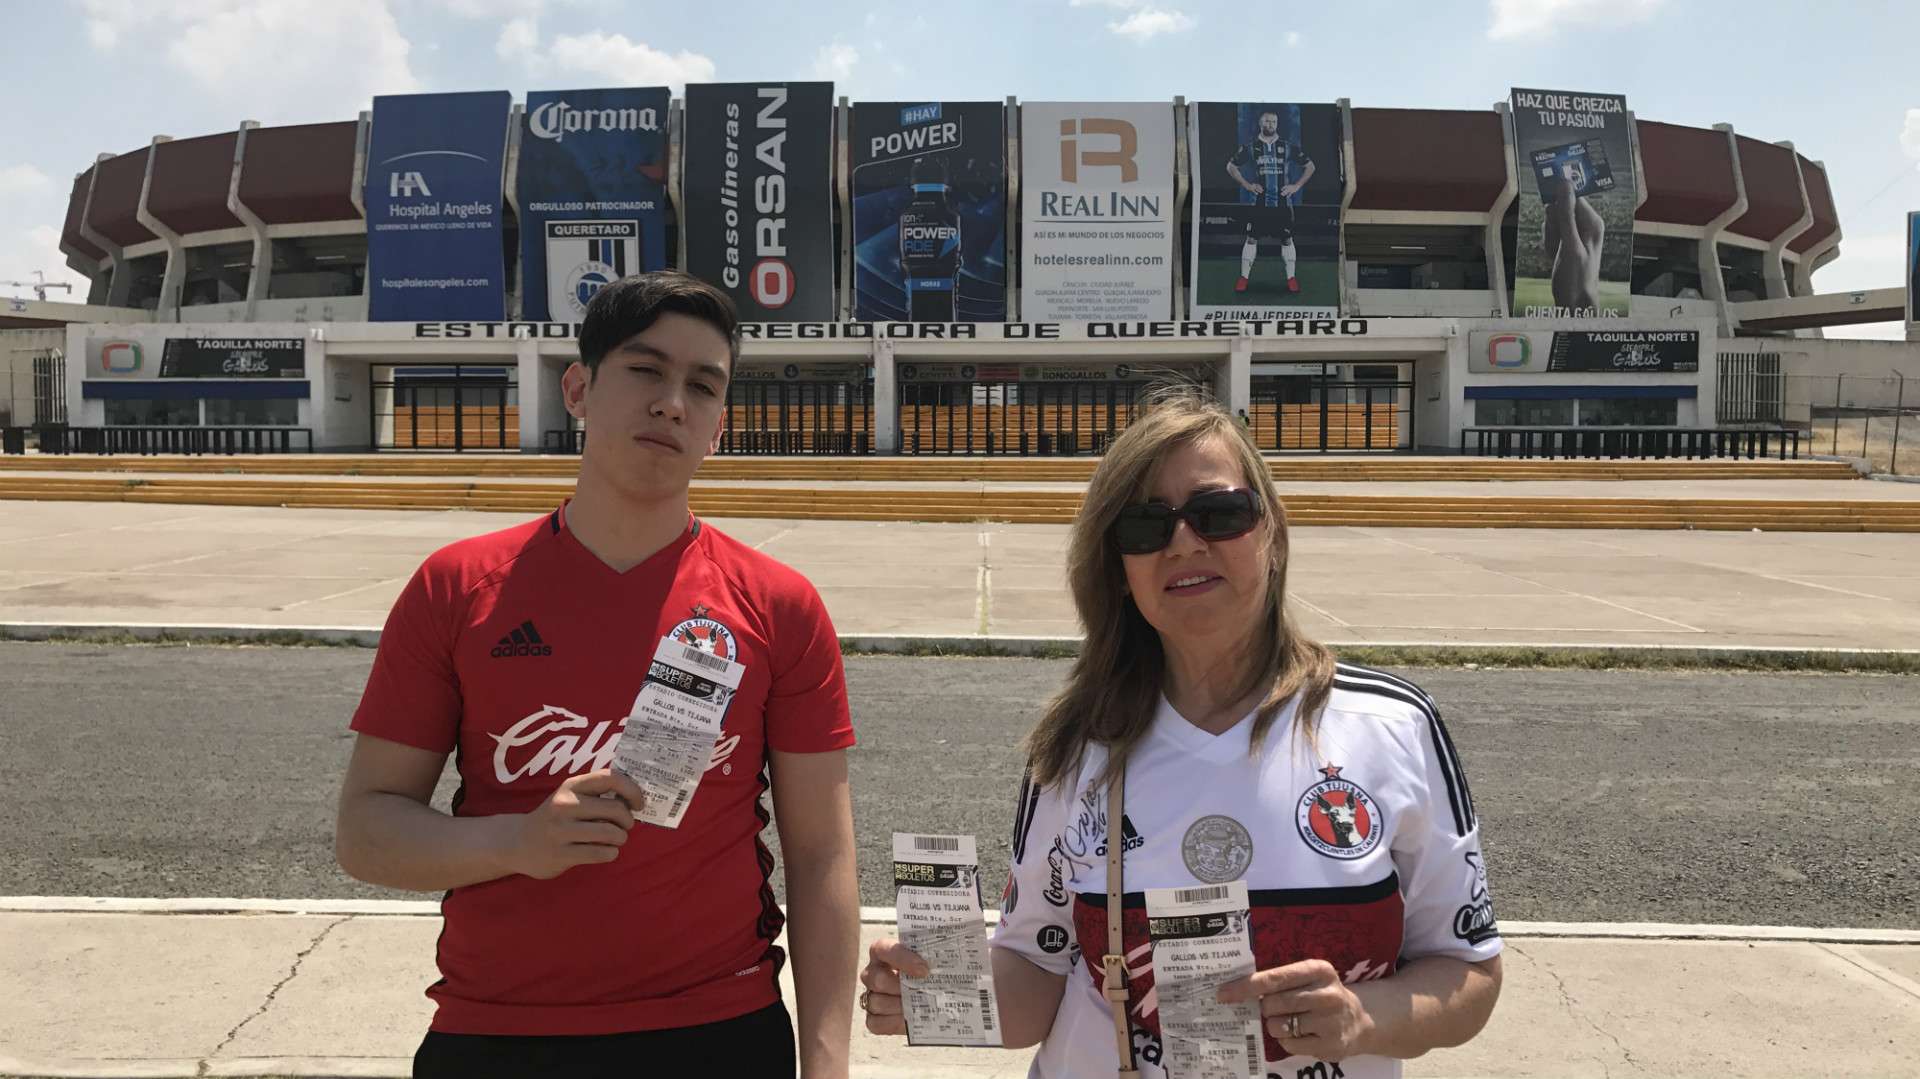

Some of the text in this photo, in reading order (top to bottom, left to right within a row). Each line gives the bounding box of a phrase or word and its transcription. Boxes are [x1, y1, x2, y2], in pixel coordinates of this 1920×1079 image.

[1516, 93, 1622, 113] HAZ QUE CREZCA
[529, 101, 659, 142] Corona
[904, 106, 937, 124] #HAY
[1537, 109, 1605, 129] TU PASIÓN
[871, 122, 958, 158] POWER
[722, 103, 740, 288] Gasolineras
[389, 201, 493, 220] Hospital Angeles
[529, 201, 655, 211] ORGULLOSO PATROCINADOR
[554, 225, 630, 236] QUERETARO
[904, 227, 957, 240] POWER
[1068, 231, 1098, 239] MUNDO
[1126, 231, 1165, 239] NEGOCIOS
[1034, 253, 1164, 266] hotelesrealinn.com
[382, 278, 489, 289] hospitalesangeles.com
[416, 320, 1368, 340] ESTADI REGIDORA DE QUERETARO
[1587, 332, 1696, 342] TAQUILLA NORTE 1
[196, 340, 302, 349] TAQUILLA NORTE 2
[672, 620, 730, 639] CLUB TIJUANA
[490, 643, 553, 658] adidas
[1302, 782, 1369, 807] CLUB TIJUANA
[902, 864, 935, 874] SUPER
[909, 902, 931, 910] GALLOS
[944, 903, 971, 912] TIJUANA
[1158, 917, 1201, 928] SUPER
[1171, 949, 1242, 961] GALLOS VS TIJUANA
